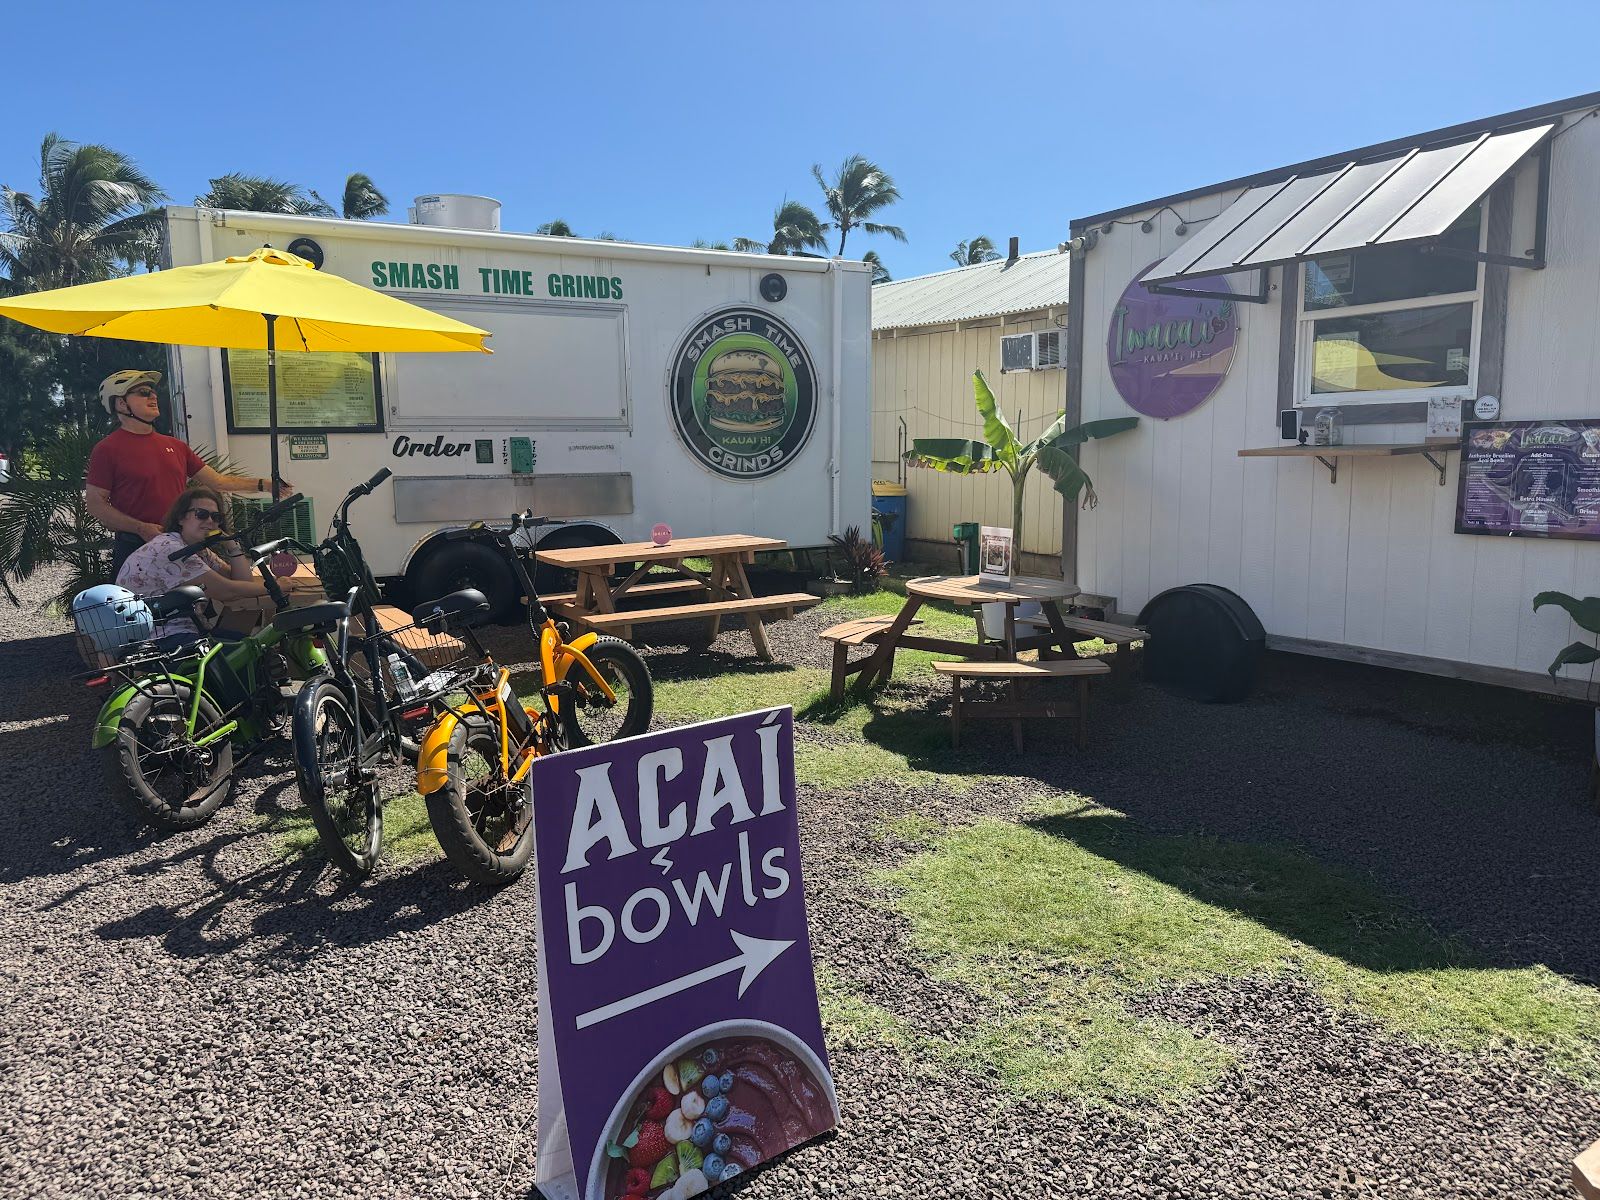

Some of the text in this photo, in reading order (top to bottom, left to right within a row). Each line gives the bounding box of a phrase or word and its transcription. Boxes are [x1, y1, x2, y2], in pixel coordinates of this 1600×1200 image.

[371, 260, 624, 300] SMASH TIME GRINDS
[687, 317, 803, 369] SMASH TIME
[392, 435, 471, 458] Order
[722, 436, 757, 445] KAUAI
[708, 445, 784, 472] GRINDS
[564, 830, 790, 965] bowls
